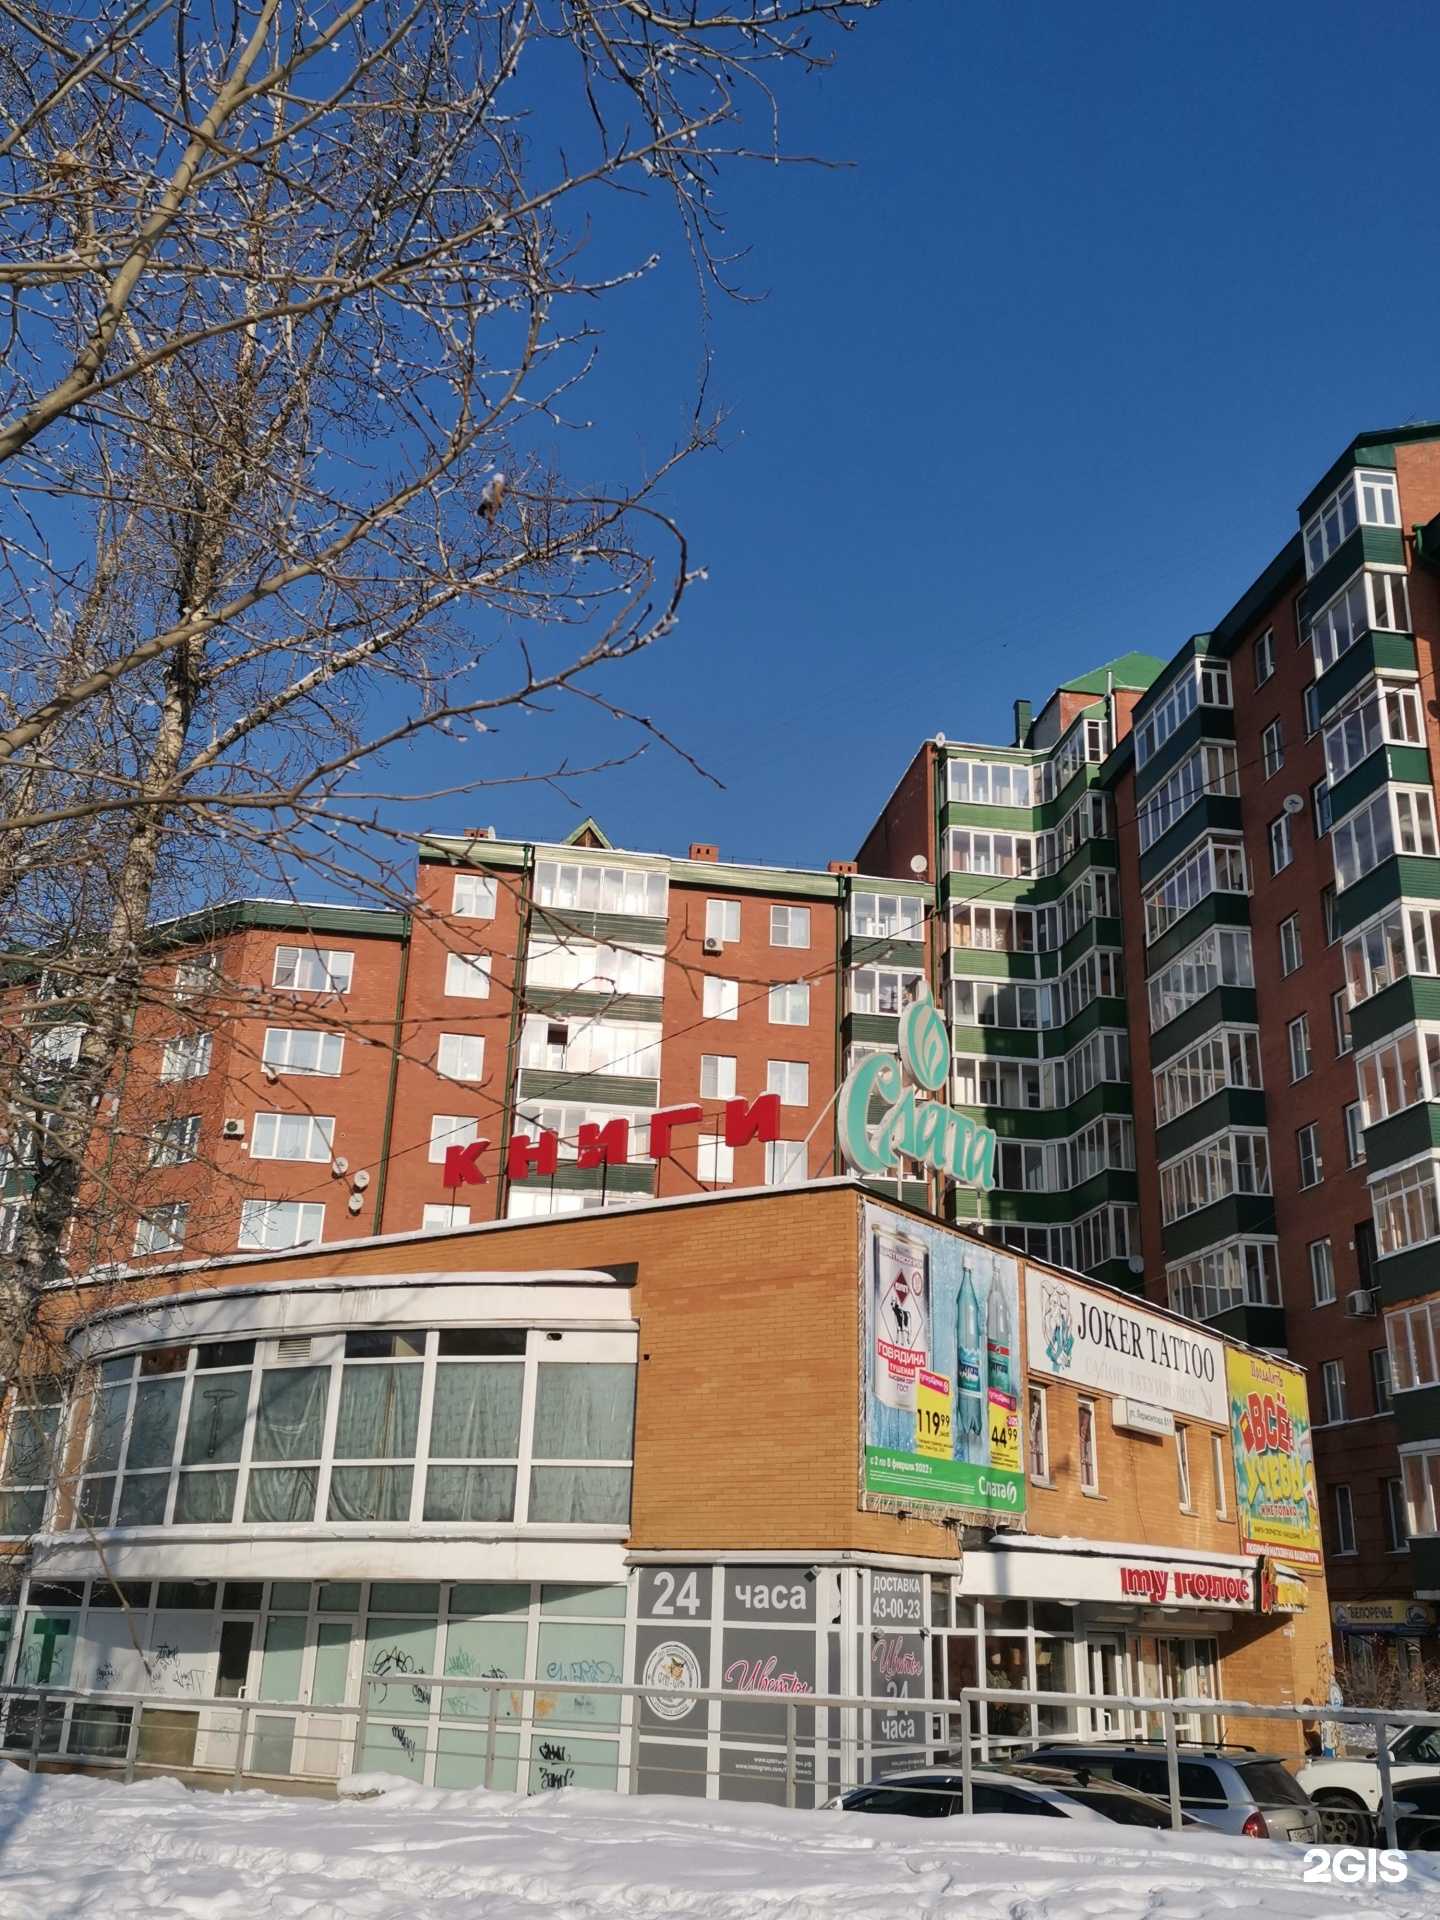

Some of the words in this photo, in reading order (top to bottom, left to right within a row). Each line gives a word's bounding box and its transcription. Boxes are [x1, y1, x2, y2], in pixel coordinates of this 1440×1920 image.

[443, 1091, 781, 1188] КНИГИ
[838, 1052, 997, 1192] Слата
[878, 1342, 926, 1366] ГОВЯДИНА
[1078, 1302, 1144, 1361] JOKER
[1147, 1327, 1215, 1382] TATTOO
[1247, 1391, 1292, 1454] ВСЁ
[979, 1476, 1007, 1498] Слата
[652, 1571, 700, 1616] 24
[735, 1584, 807, 1609] часа
[873, 1575, 921, 1594] ДОСТАВКА
[873, 1597, 921, 1620] 43-00-23
[871, 1636, 923, 1681] Цветы
[886, 1680, 910, 1717] 24
[881, 1718, 916, 1740] часа
